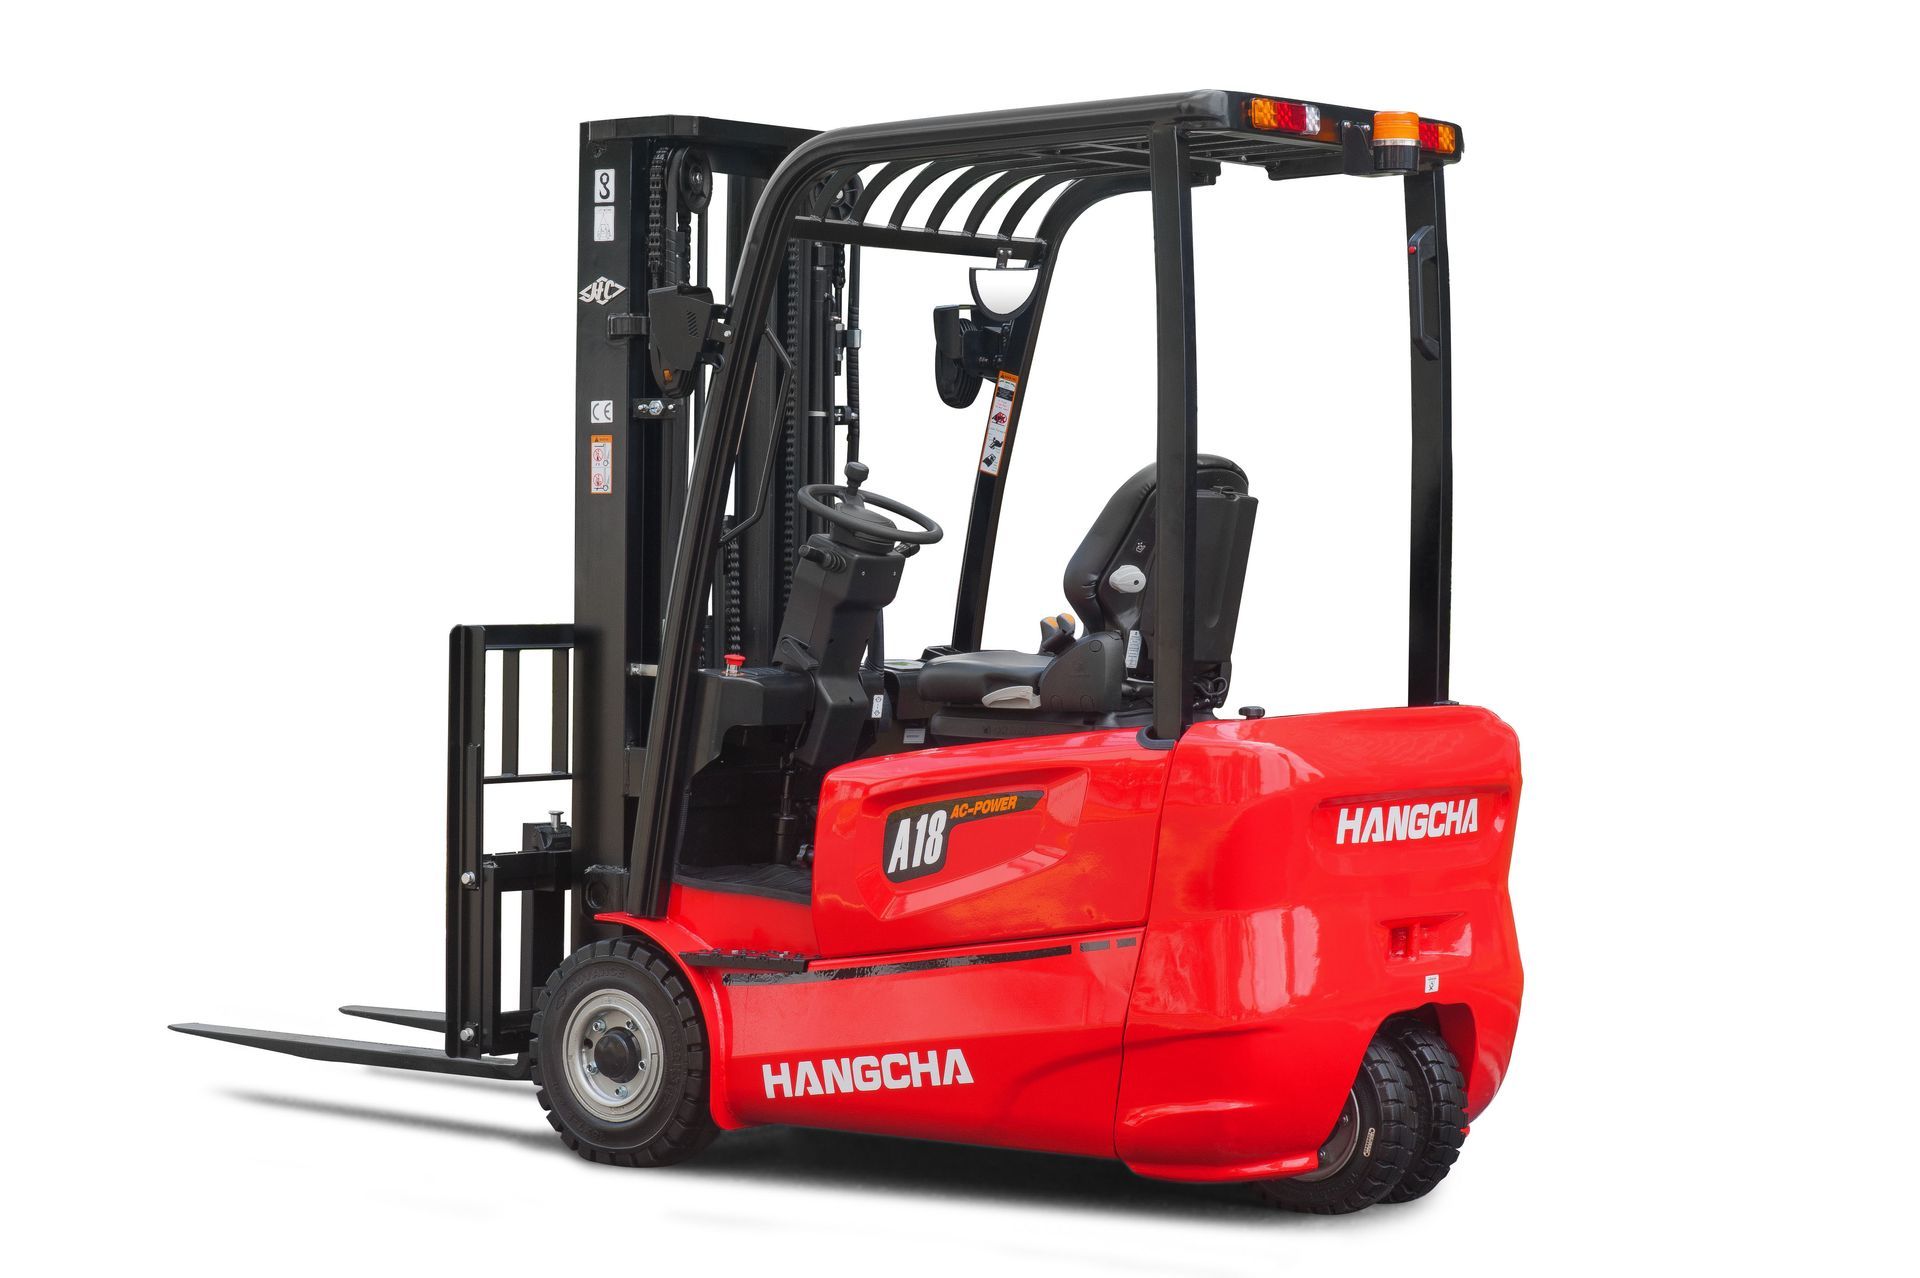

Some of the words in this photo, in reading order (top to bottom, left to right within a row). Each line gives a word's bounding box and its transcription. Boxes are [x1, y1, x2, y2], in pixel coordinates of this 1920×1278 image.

[592, 402, 611, 421] CE
[950, 795, 1018, 819] AC-POWER
[1336, 798, 1478, 845] HANGCHA
[887, 809, 947, 874] A18
[762, 1049, 975, 1099] HANGCHA
